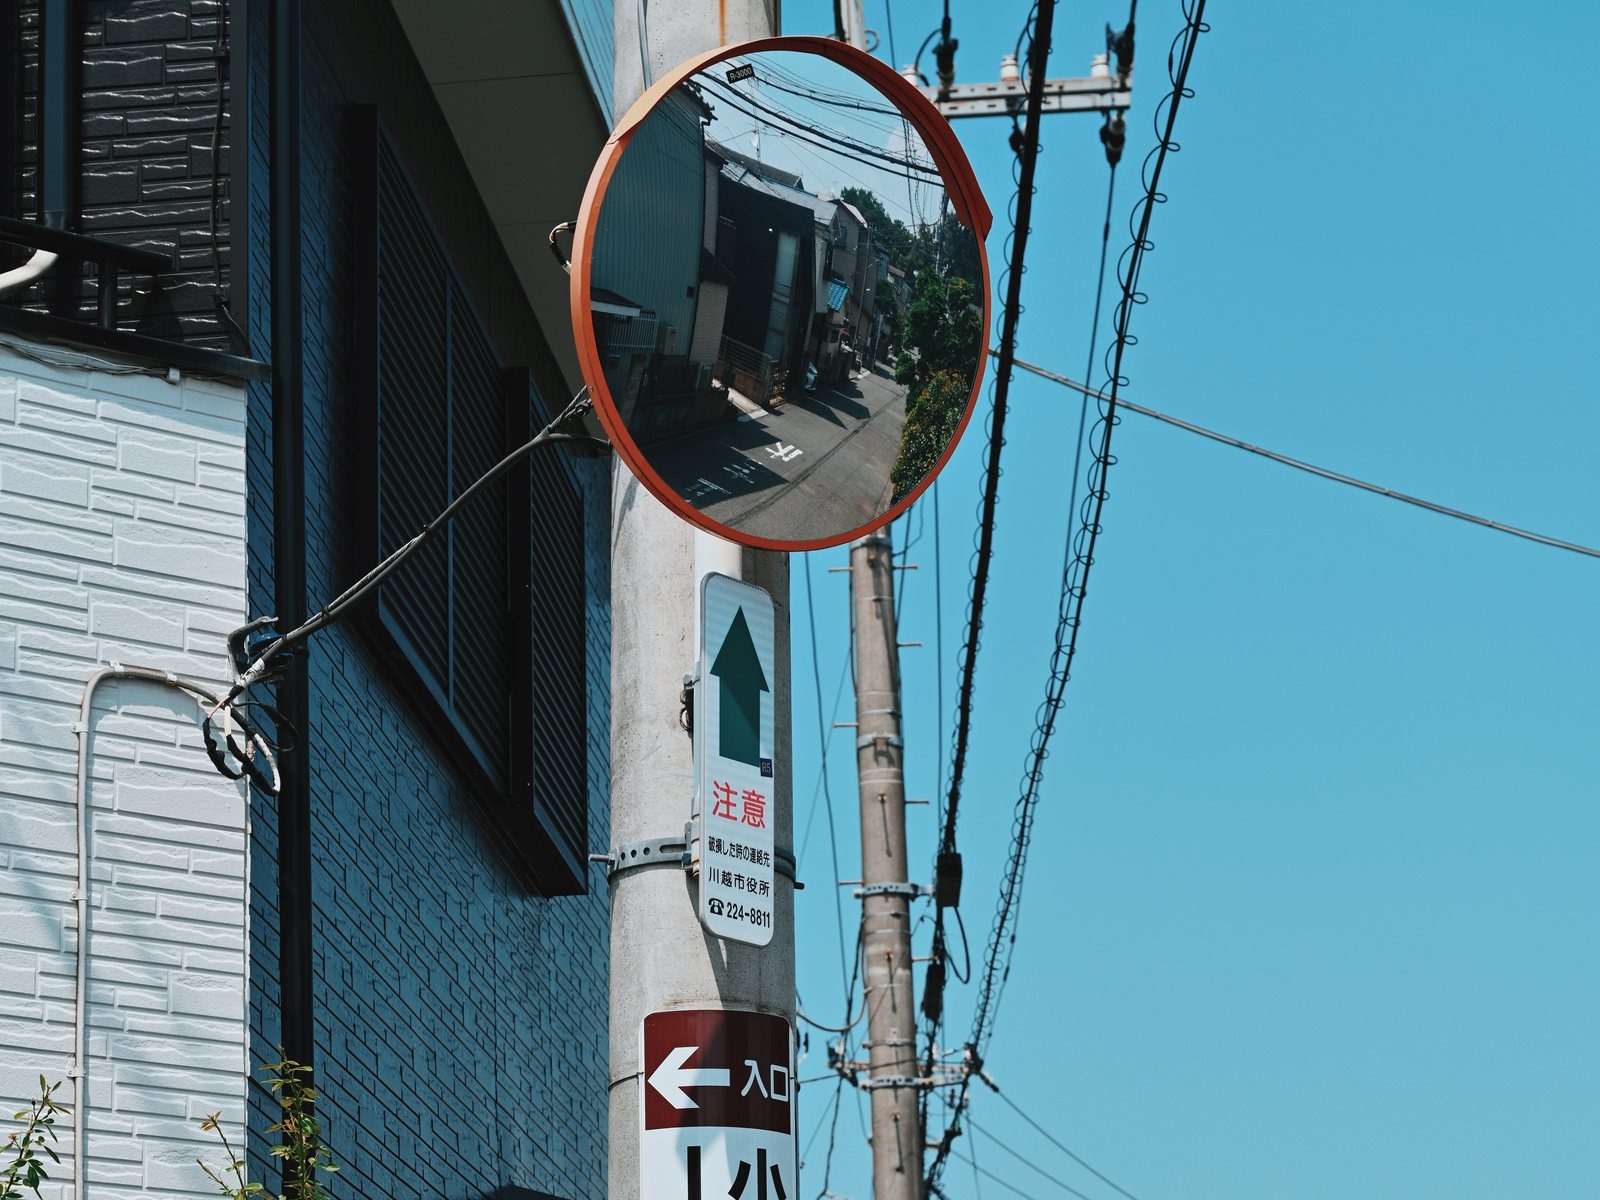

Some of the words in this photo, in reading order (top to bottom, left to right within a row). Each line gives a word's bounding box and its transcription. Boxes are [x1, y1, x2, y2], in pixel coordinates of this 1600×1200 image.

[712, 780, 766, 829] 注意
[708, 835, 771, 868] 破損した時の連絡先
[708, 866, 770, 898] 川越市役所
[726, 901, 771, 928] 224-8811
[740, 1059, 789, 1103] 入口
